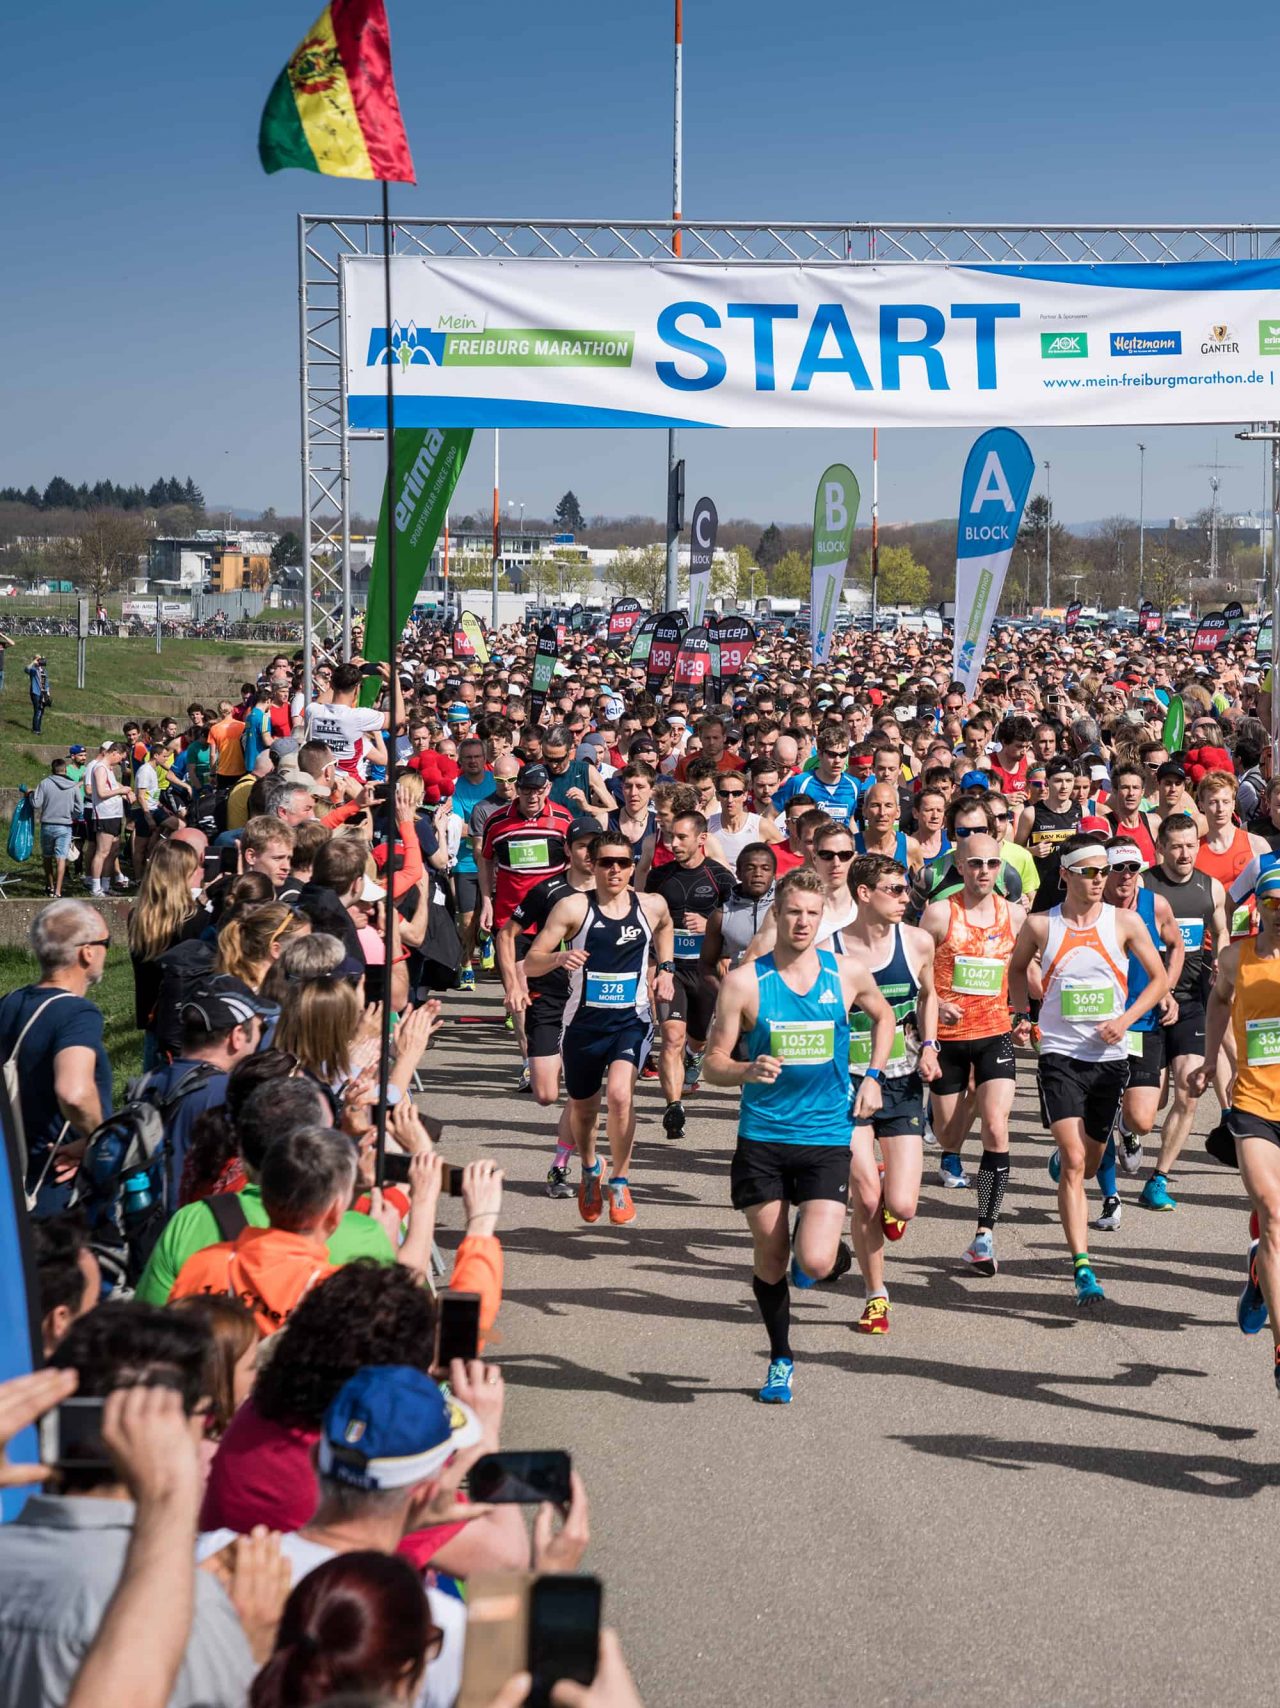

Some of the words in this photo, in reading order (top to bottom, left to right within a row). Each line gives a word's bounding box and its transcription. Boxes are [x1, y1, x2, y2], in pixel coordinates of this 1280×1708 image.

[439, 314, 477, 329] Mein
[449, 340, 529, 355] FREIBURG
[534, 341, 628, 357] MARATHON
[655, 301, 1021, 392] START
[1048, 336, 1081, 350] AOK
[1201, 343, 1240, 354] GANTER
[1043, 369, 1264, 388] www.mein-freiburgmarathon.de
[970, 450, 1016, 514] A
[409, 492, 438, 548] SPORTSWEAR
[433, 466, 449, 494] SINCE
[445, 445, 457, 470] 1900
[825, 481, 848, 532] B
[696, 510, 711, 549] C
[965, 526, 1009, 541] BLOCK
[817, 541, 846, 553] BLOCK
[692, 554, 710, 565] BLOCK
[624, 603, 637, 612] cep
[1229, 609, 1241, 617] cep
[612, 616, 632, 628] 1:59
[1210, 620, 1225, 628] cep
[663, 628, 678, 641] cep
[727, 627, 748, 640] cep
[456, 637, 470, 649] 1:4
[1197, 635, 1218, 645] 1:44
[651, 650, 671, 667] 1:29
[679, 659, 704, 677] 1:29
[522, 848, 534, 856] 15
[678, 937, 696, 947] 108
[961, 966, 996, 980] 10471
[964, 977, 990, 987] FLAVIO
[601, 983, 624, 994] 378
[599, 994, 625, 1002] MORITZ
[1072, 993, 1105, 1005] 3695
[1078, 1005, 1099, 1013] SVEN
[780, 1034, 825, 1047] 10573
[777, 1047, 827, 1057] SEBASTIAN
